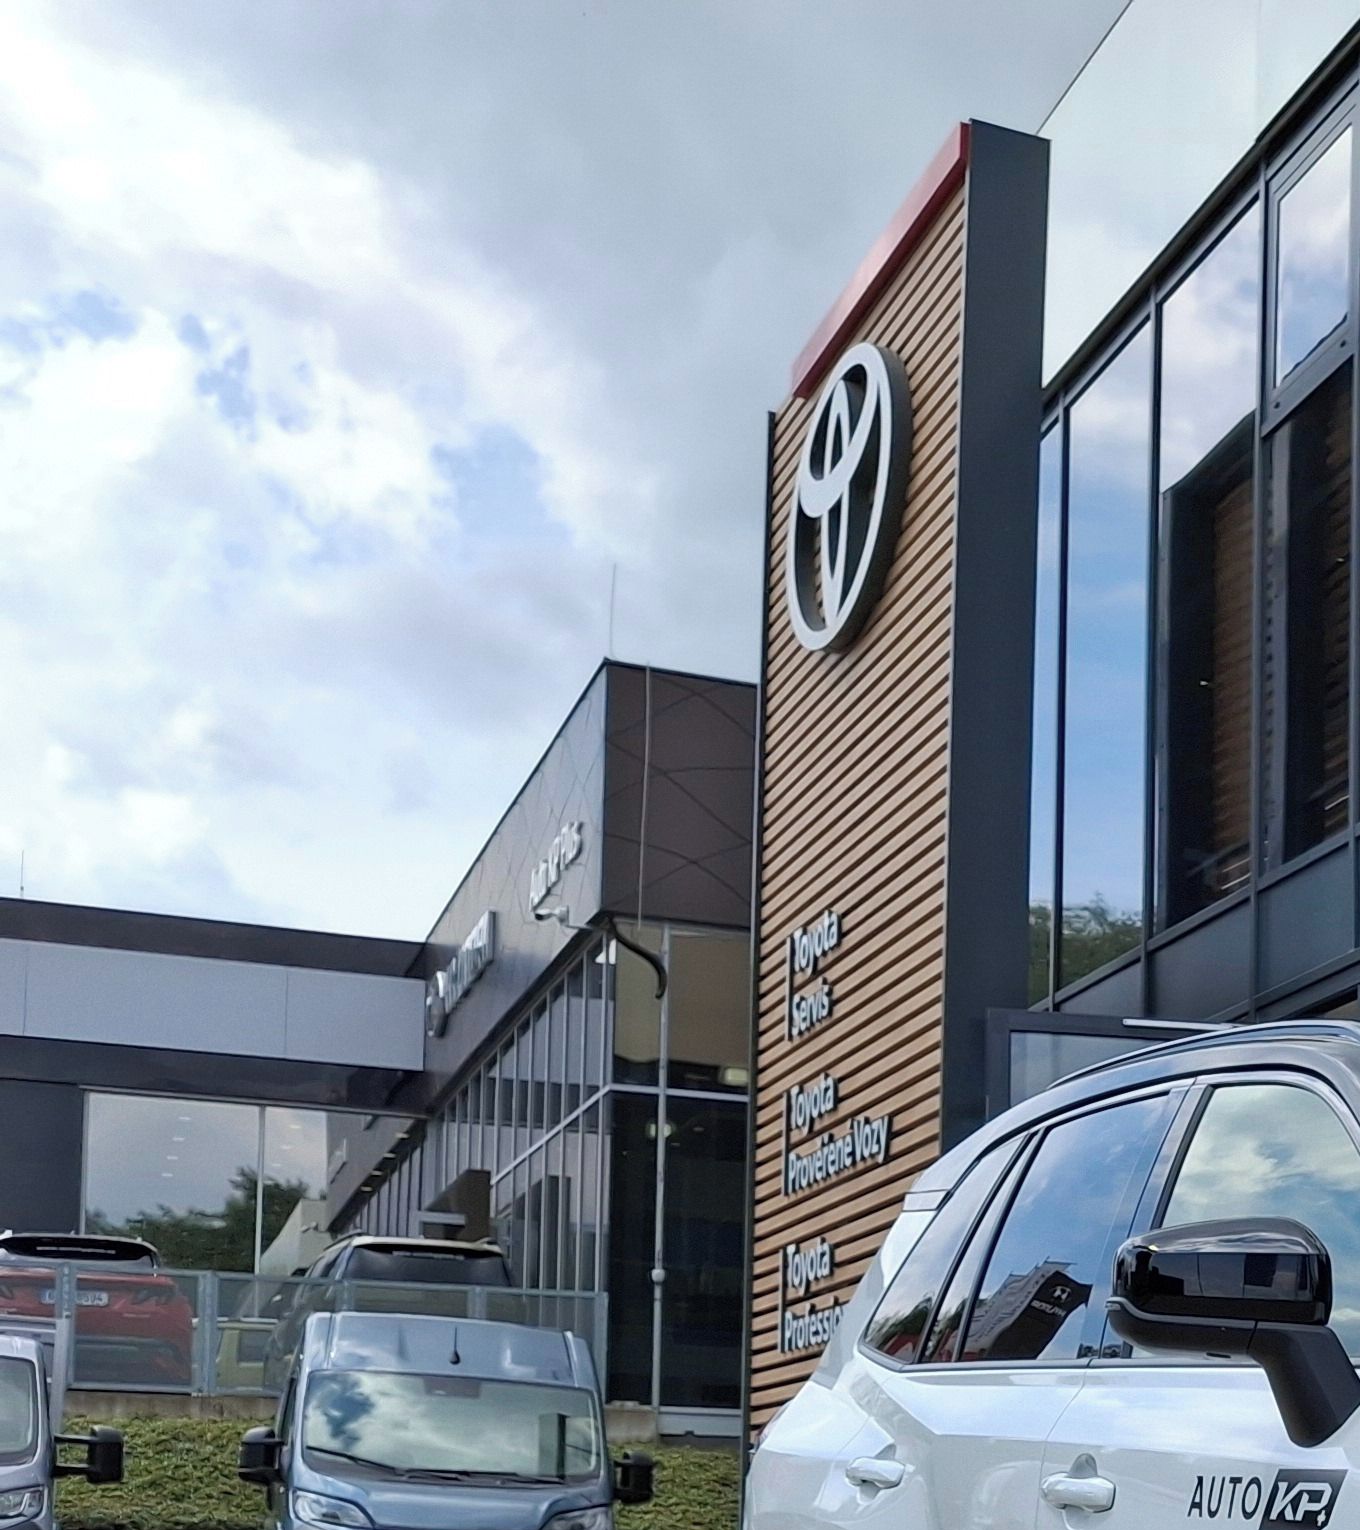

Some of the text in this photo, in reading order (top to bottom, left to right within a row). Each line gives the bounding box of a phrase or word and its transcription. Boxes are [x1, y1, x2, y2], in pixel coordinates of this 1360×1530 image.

[792, 909, 839, 977] Toyota
[791, 977, 830, 1036] Servis
[789, 1071, 834, 1137] Toyota
[853, 1115, 889, 1164] Vozy
[786, 1236, 831, 1297] Toyota
[784, 1294, 843, 1352] Professio
[1187, 1475, 1262, 1520] AUTO
